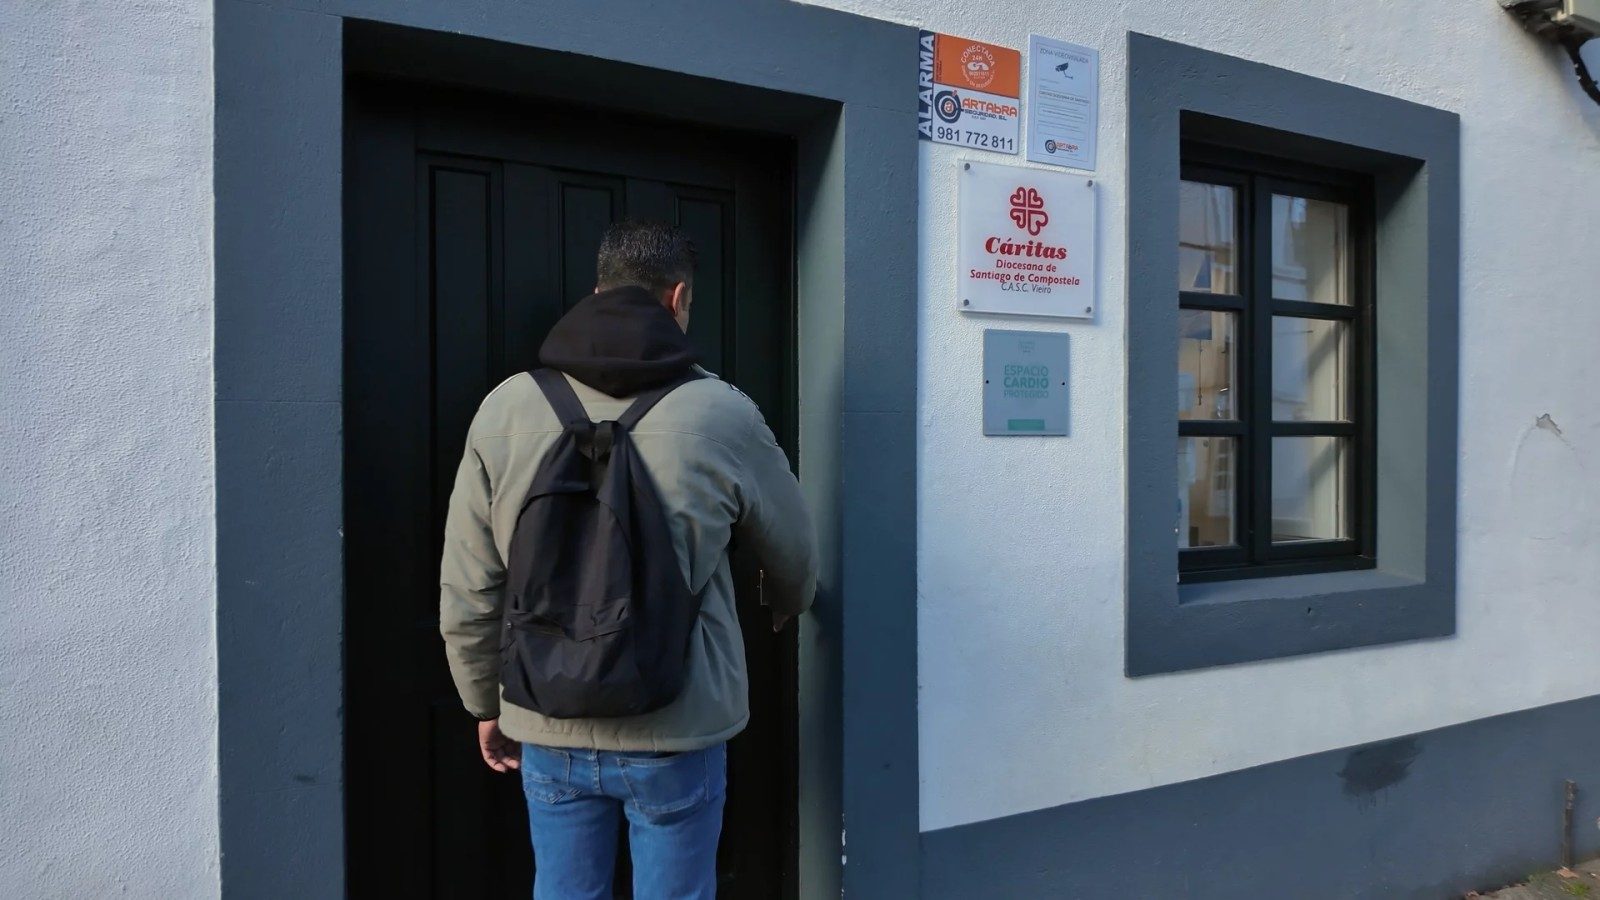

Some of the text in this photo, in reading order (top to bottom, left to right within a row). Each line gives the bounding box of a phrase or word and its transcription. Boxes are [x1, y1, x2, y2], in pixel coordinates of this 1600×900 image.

[1040, 48, 1053, 56] ZONA
[918, 35, 934, 138] ALARMA
[937, 126, 1013, 151] 981 772 811
[985, 237, 1067, 260] Cáritas
[996, 259, 1057, 272] Diocesana de
[970, 269, 1080, 286] Santiago de Compostela
[1031, 285, 1052, 294] Vieiro
[1004, 364, 1049, 377] ESPACIO
[1003, 377, 1049, 389] CARDIO
[1004, 389, 1049, 399] PROTEGIDO
